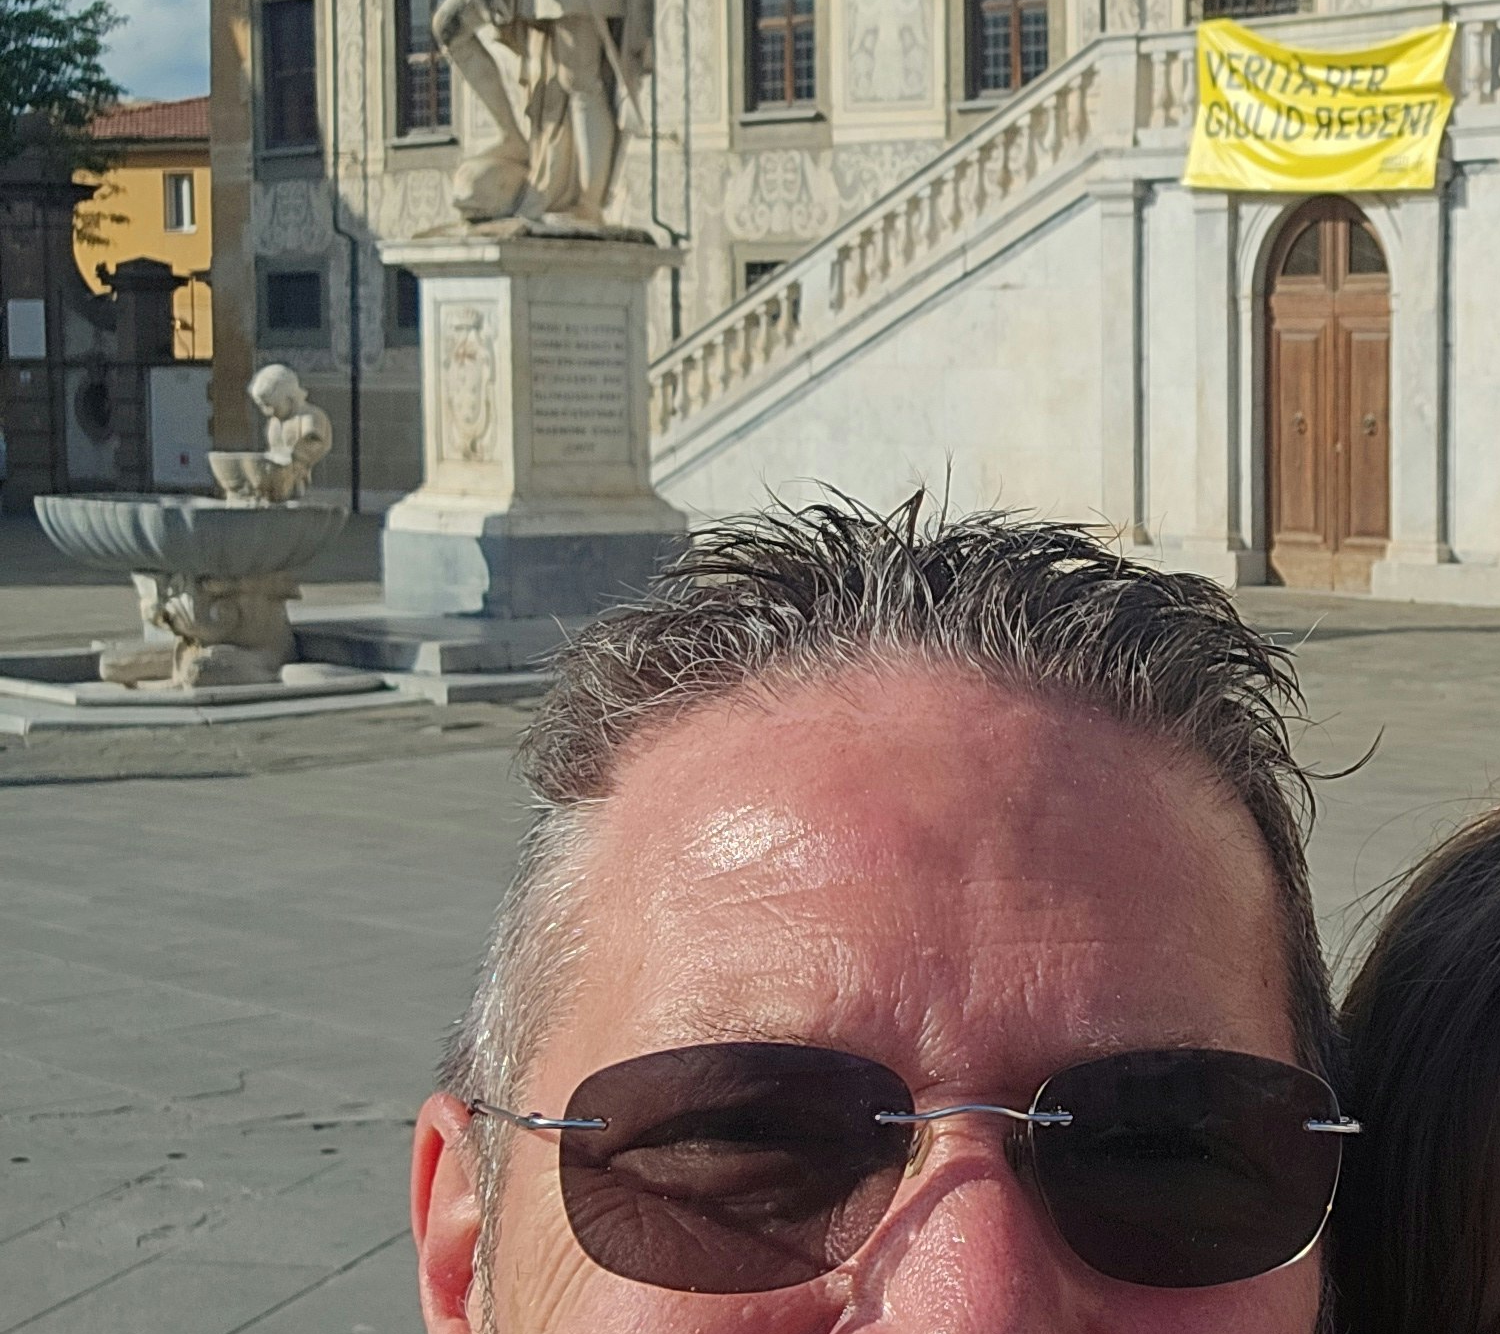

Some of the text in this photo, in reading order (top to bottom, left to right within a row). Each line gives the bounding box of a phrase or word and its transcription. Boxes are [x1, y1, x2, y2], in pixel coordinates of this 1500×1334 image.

[1206, 50, 1389, 98] VERITÀ PER
[1205, 99, 1439, 141] GIULIO REGENI
